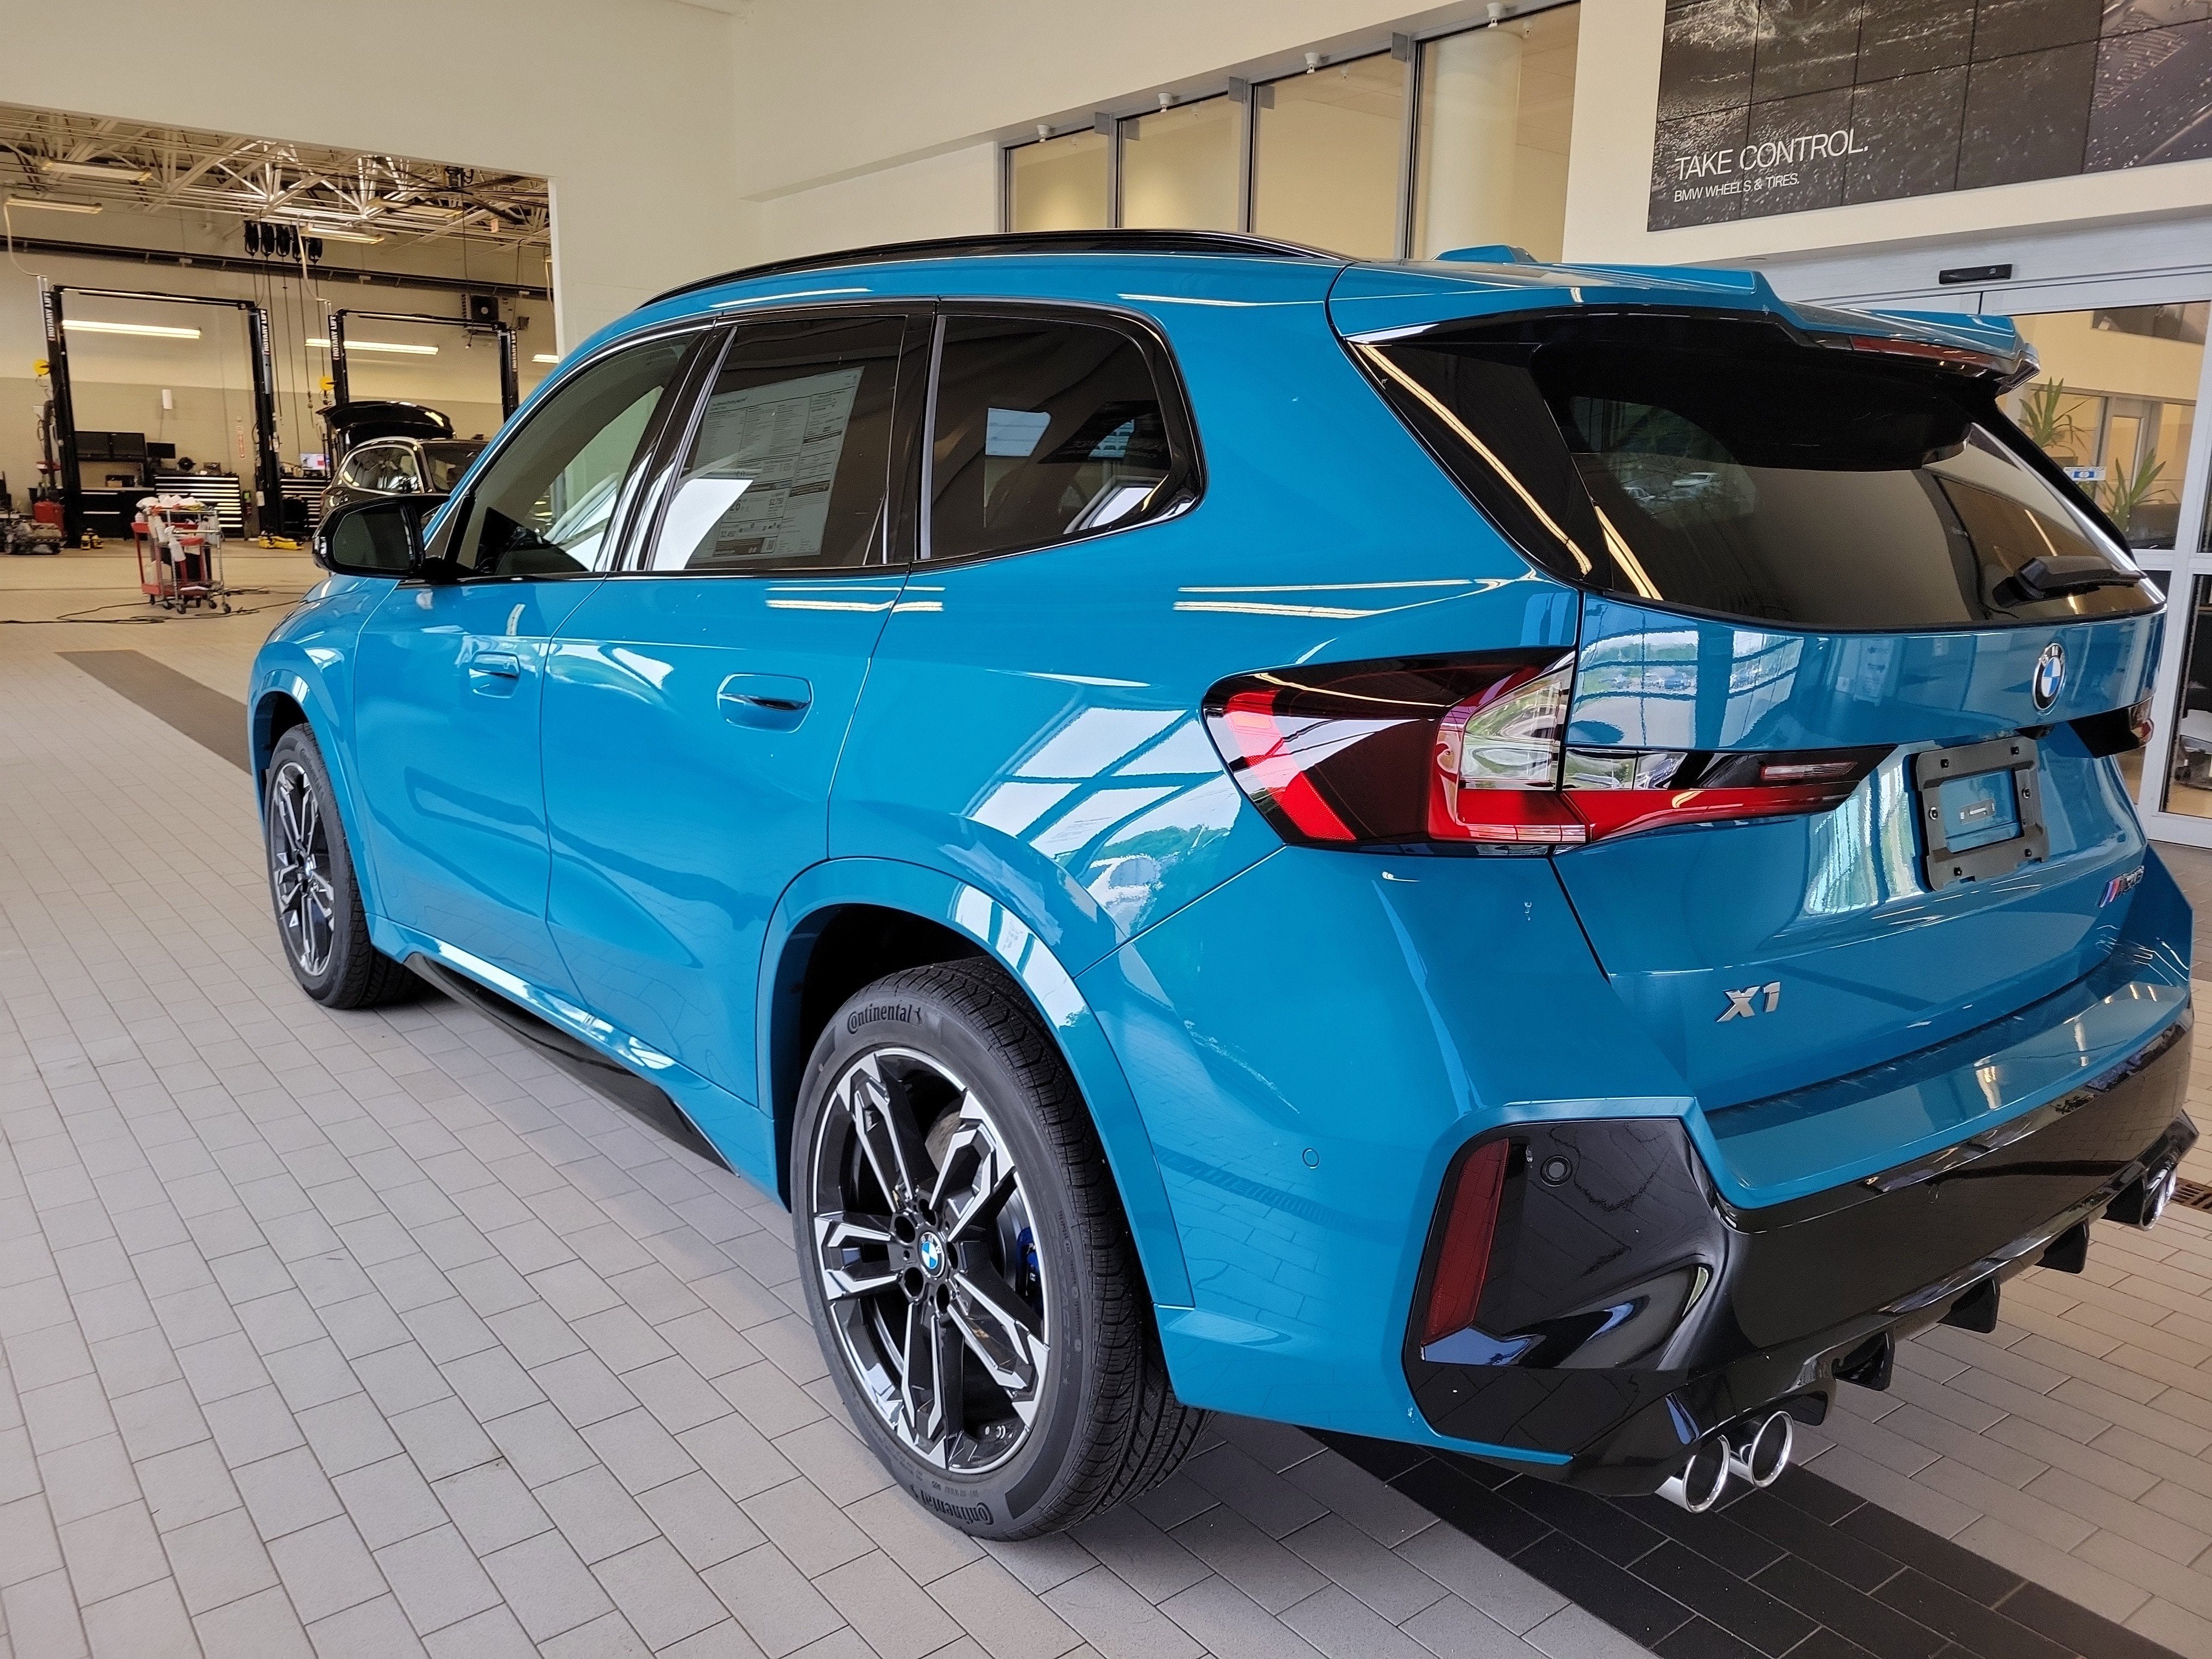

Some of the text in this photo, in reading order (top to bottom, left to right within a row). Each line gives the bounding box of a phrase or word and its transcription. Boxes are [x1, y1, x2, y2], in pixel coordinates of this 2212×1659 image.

[1675, 129, 1868, 180] TAKE CONTROL.
[1674, 173, 1800, 202] BMW WHEELS & TIRES.
[44, 293, 56, 337] ROTARY LIFT
[331, 331, 340, 357] ROTARY
[847, 1003, 912, 1034] Continental
[1716, 981, 1780, 1023] X1
[920, 1489, 994, 1525] Continental
